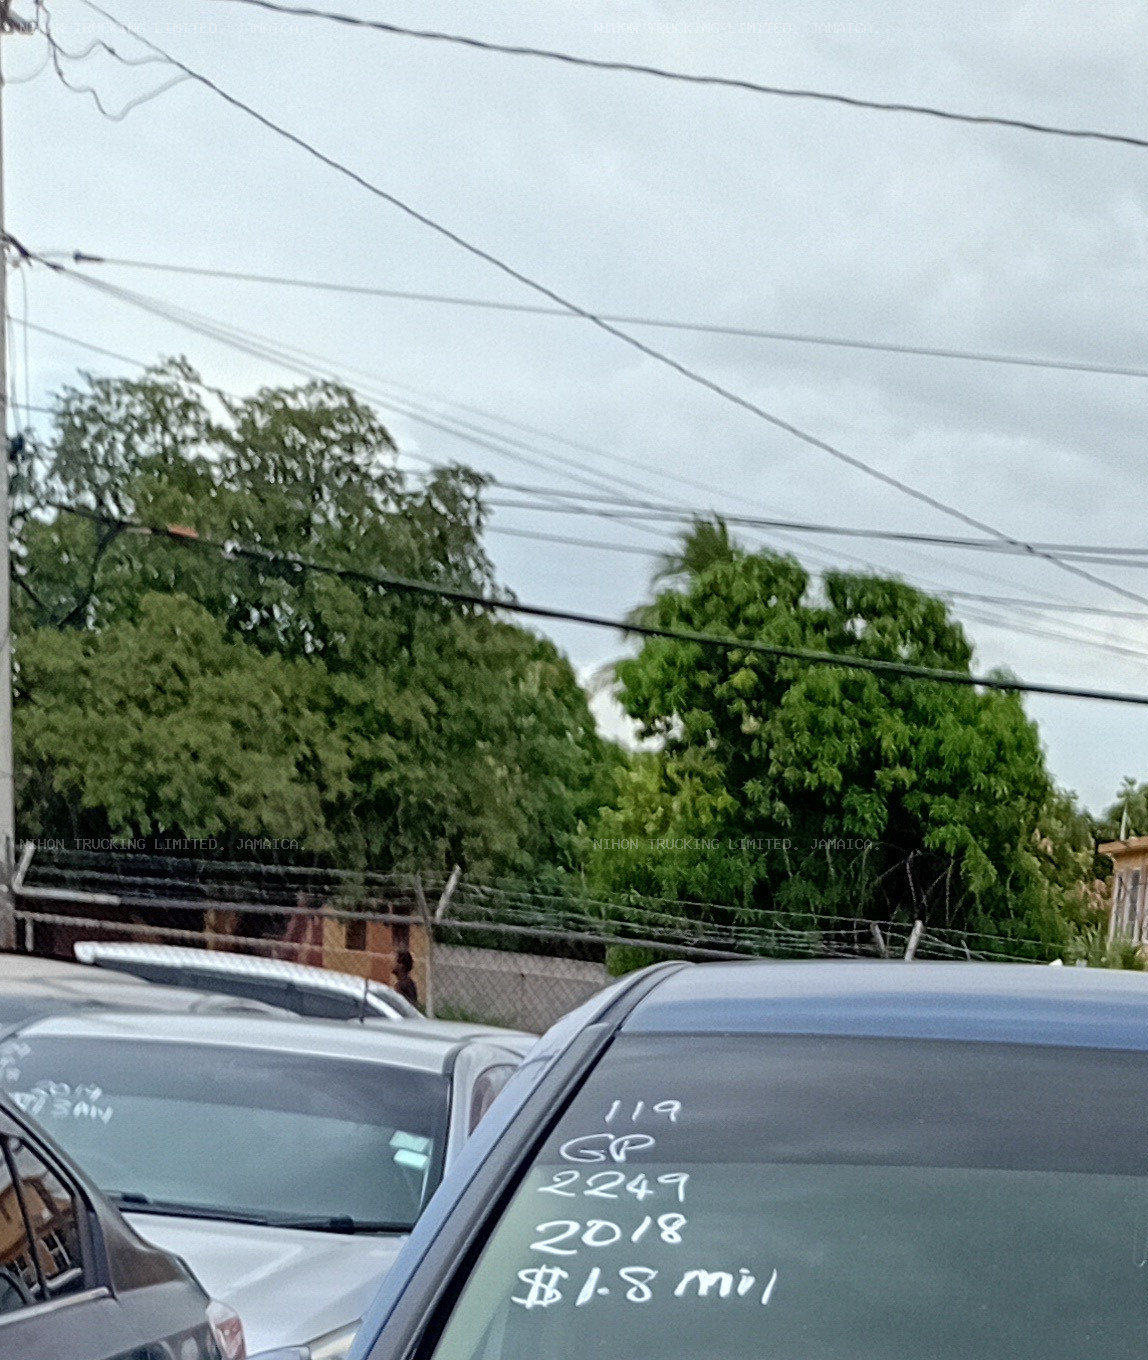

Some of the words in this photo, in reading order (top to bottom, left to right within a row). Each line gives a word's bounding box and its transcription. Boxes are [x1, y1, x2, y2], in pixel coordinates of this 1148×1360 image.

[604, 1100, 682, 1123] 119
[560, 1133, 656, 1163] GP
[538, 1170, 690, 1203] 2249
[529, 1212, 688, 1256] 2018
[511, 1264, 659, 1309] $1.8
